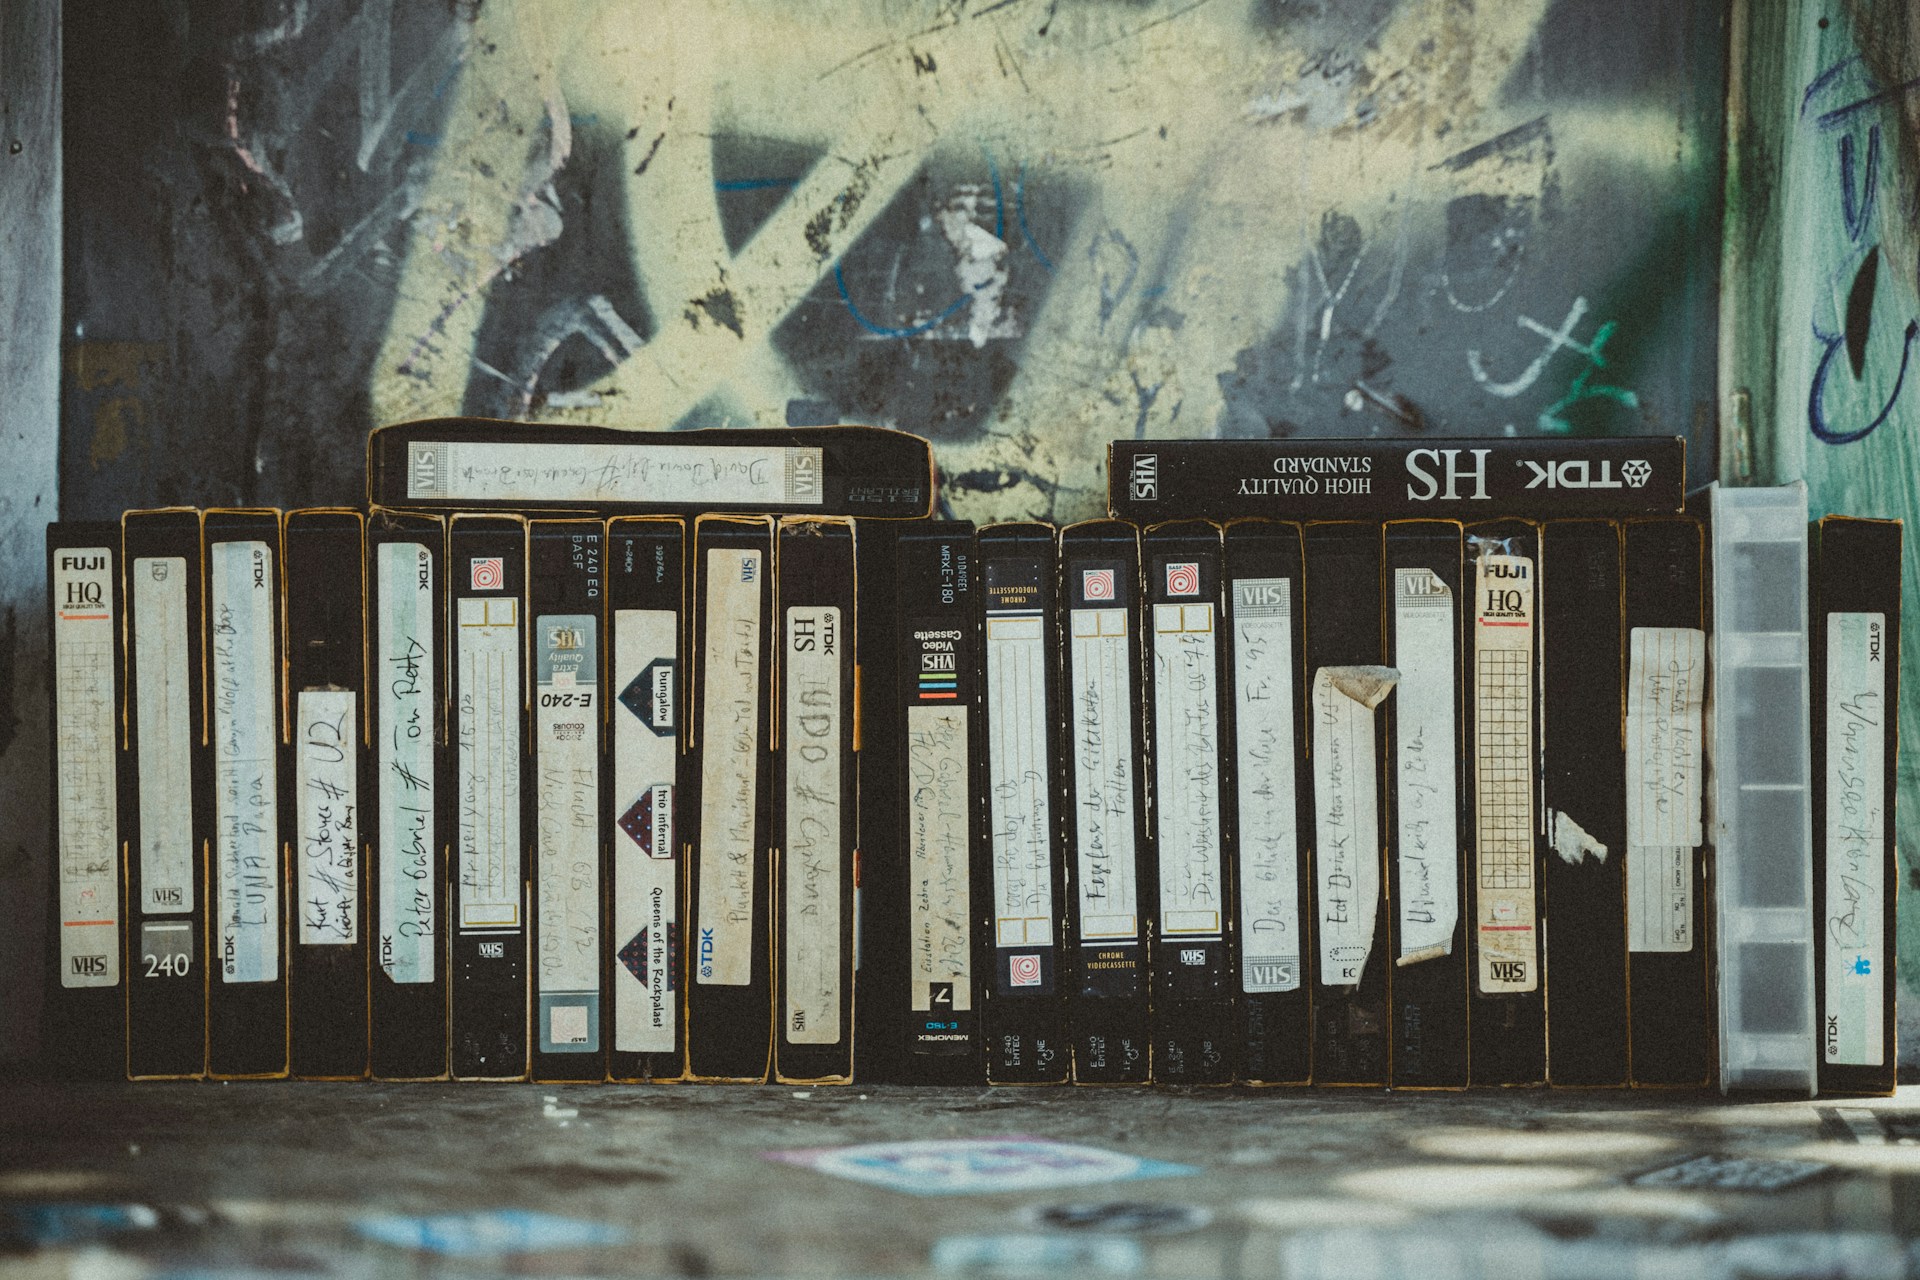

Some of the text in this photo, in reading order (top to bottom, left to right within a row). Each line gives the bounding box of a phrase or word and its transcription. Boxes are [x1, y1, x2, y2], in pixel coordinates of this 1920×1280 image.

[414, 450, 437, 491] VHS
[793, 455, 815, 495] VHS
[1134, 455, 1157, 500] VHS
[1273, 457, 1372, 473] STANDARD
[1405, 449, 1491, 501] HS
[1524, 460, 1622, 488] TDK
[1237, 475, 1371, 495] HIGH QUALITY
[61, 557, 105, 570] FUJI
[572, 535, 583, 569] BASF
[253, 559, 264, 589] TDK
[419, 561, 429, 590] TDK
[587, 535, 598, 597] E 240 EQ
[741, 558, 754, 582] VHS
[1484, 564, 1527, 579] FUJI
[66, 581, 102, 605] HQ
[1241, 584, 1282, 607] VHS
[1487, 590, 1523, 613] HQ
[794, 617, 816, 652] HS
[824, 623, 834, 656] TDK
[914, 630, 961, 641] Cassette
[922, 641, 954, 651] Video
[1870, 631, 1880, 662] TDK
[389, 636, 427, 700] Petty
[549, 653, 583, 663] Quality
[923, 653, 955, 671] VHS
[541, 694, 592, 707] E-240
[655, 671, 671, 722] bungalow
[308, 707, 347, 763] U2
[658, 790, 668, 855] trio infernal
[399, 807, 432, 880] Gabriel
[153, 888, 181, 902] VHS
[242, 853, 273, 925] LUNA
[304, 897, 330, 930] Kurt
[399, 889, 434, 938] Peter
[1326, 899, 1347, 923] Eat
[225, 936, 234, 966] TDK
[383, 935, 392, 962] TDK
[479, 943, 503, 955] VHS
[650, 887, 664, 1028] Queens of the Rockpalast
[701, 928, 713, 966] TDK
[1181, 950, 1205, 962] VHS
[73, 956, 106, 973] VHS
[144, 954, 190, 977] 240
[1087, 961, 1136, 969] VIDEOCASSETTE
[1250, 963, 1292, 986] VHS
[1342, 968, 1356, 978] EC
[1491, 962, 1525, 979] VHS
[935, 987, 951, 1003] 7
[793, 1010, 806, 1031] VHS
[1828, 1013, 1837, 1044] TDK
[1012, 1035, 1020, 1066] EMTEC
[1089, 1036, 1097, 1055] 240
[1098, 1036, 1106, 1067] EMTEC
